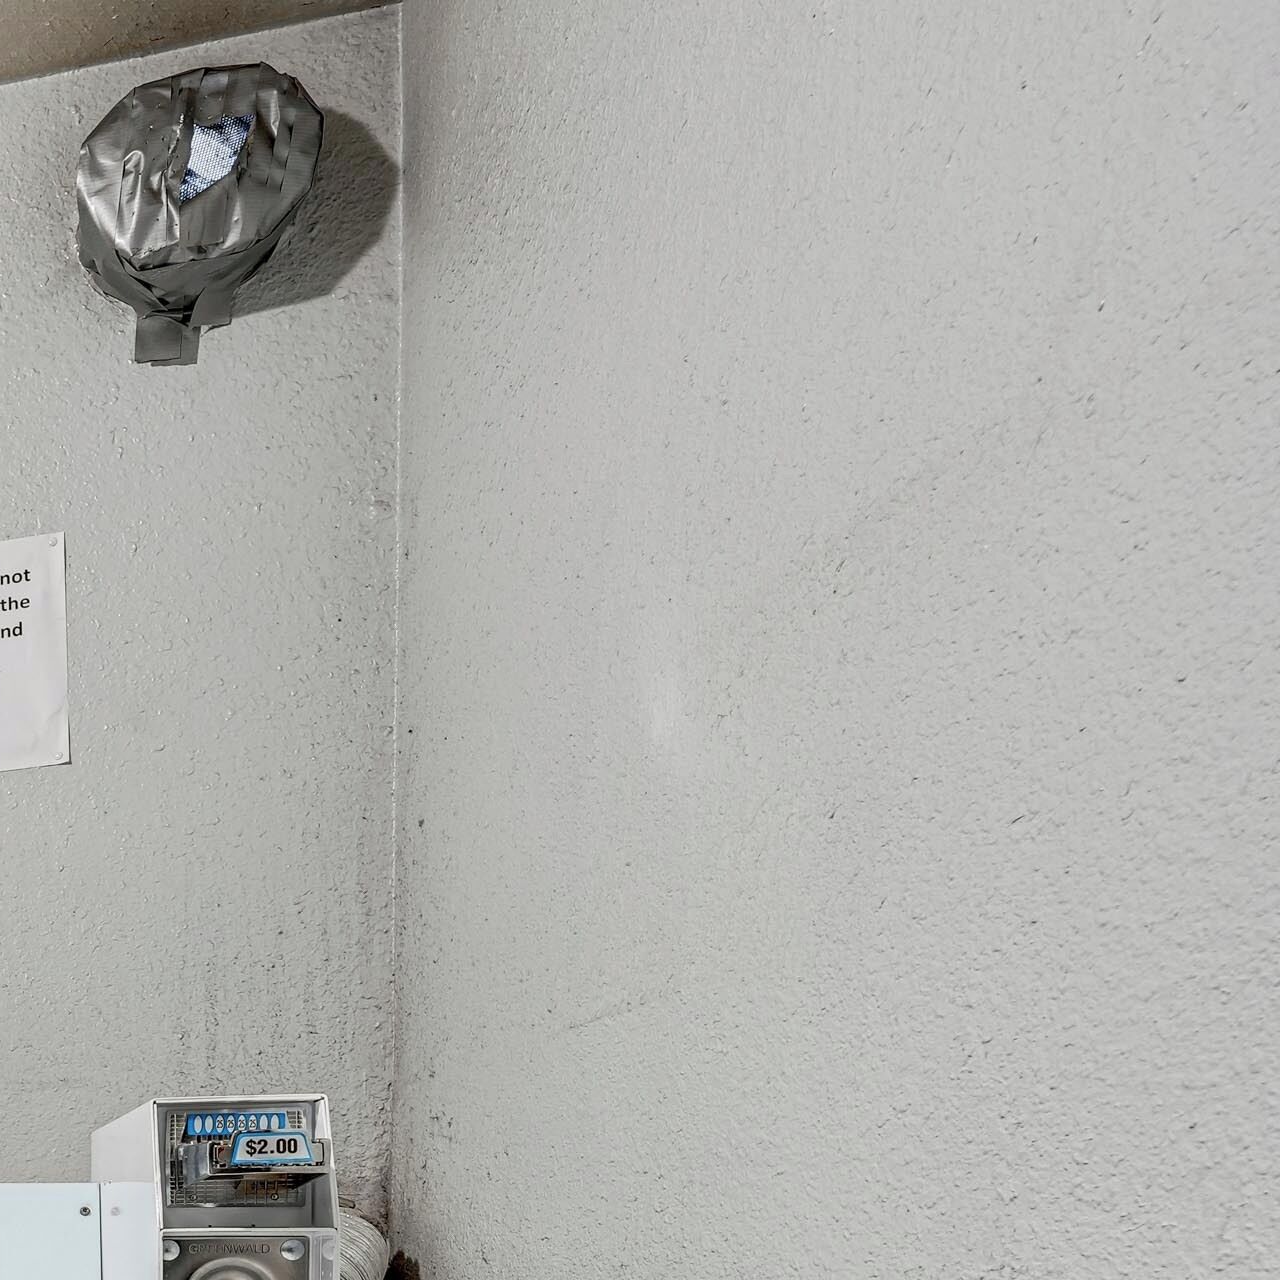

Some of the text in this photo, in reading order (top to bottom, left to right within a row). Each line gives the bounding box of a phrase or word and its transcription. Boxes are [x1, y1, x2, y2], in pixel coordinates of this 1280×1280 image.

[0, 569, 31, 586] not
[0, 596, 30, 612] the
[245, 1138, 298, 1157] $2.00
